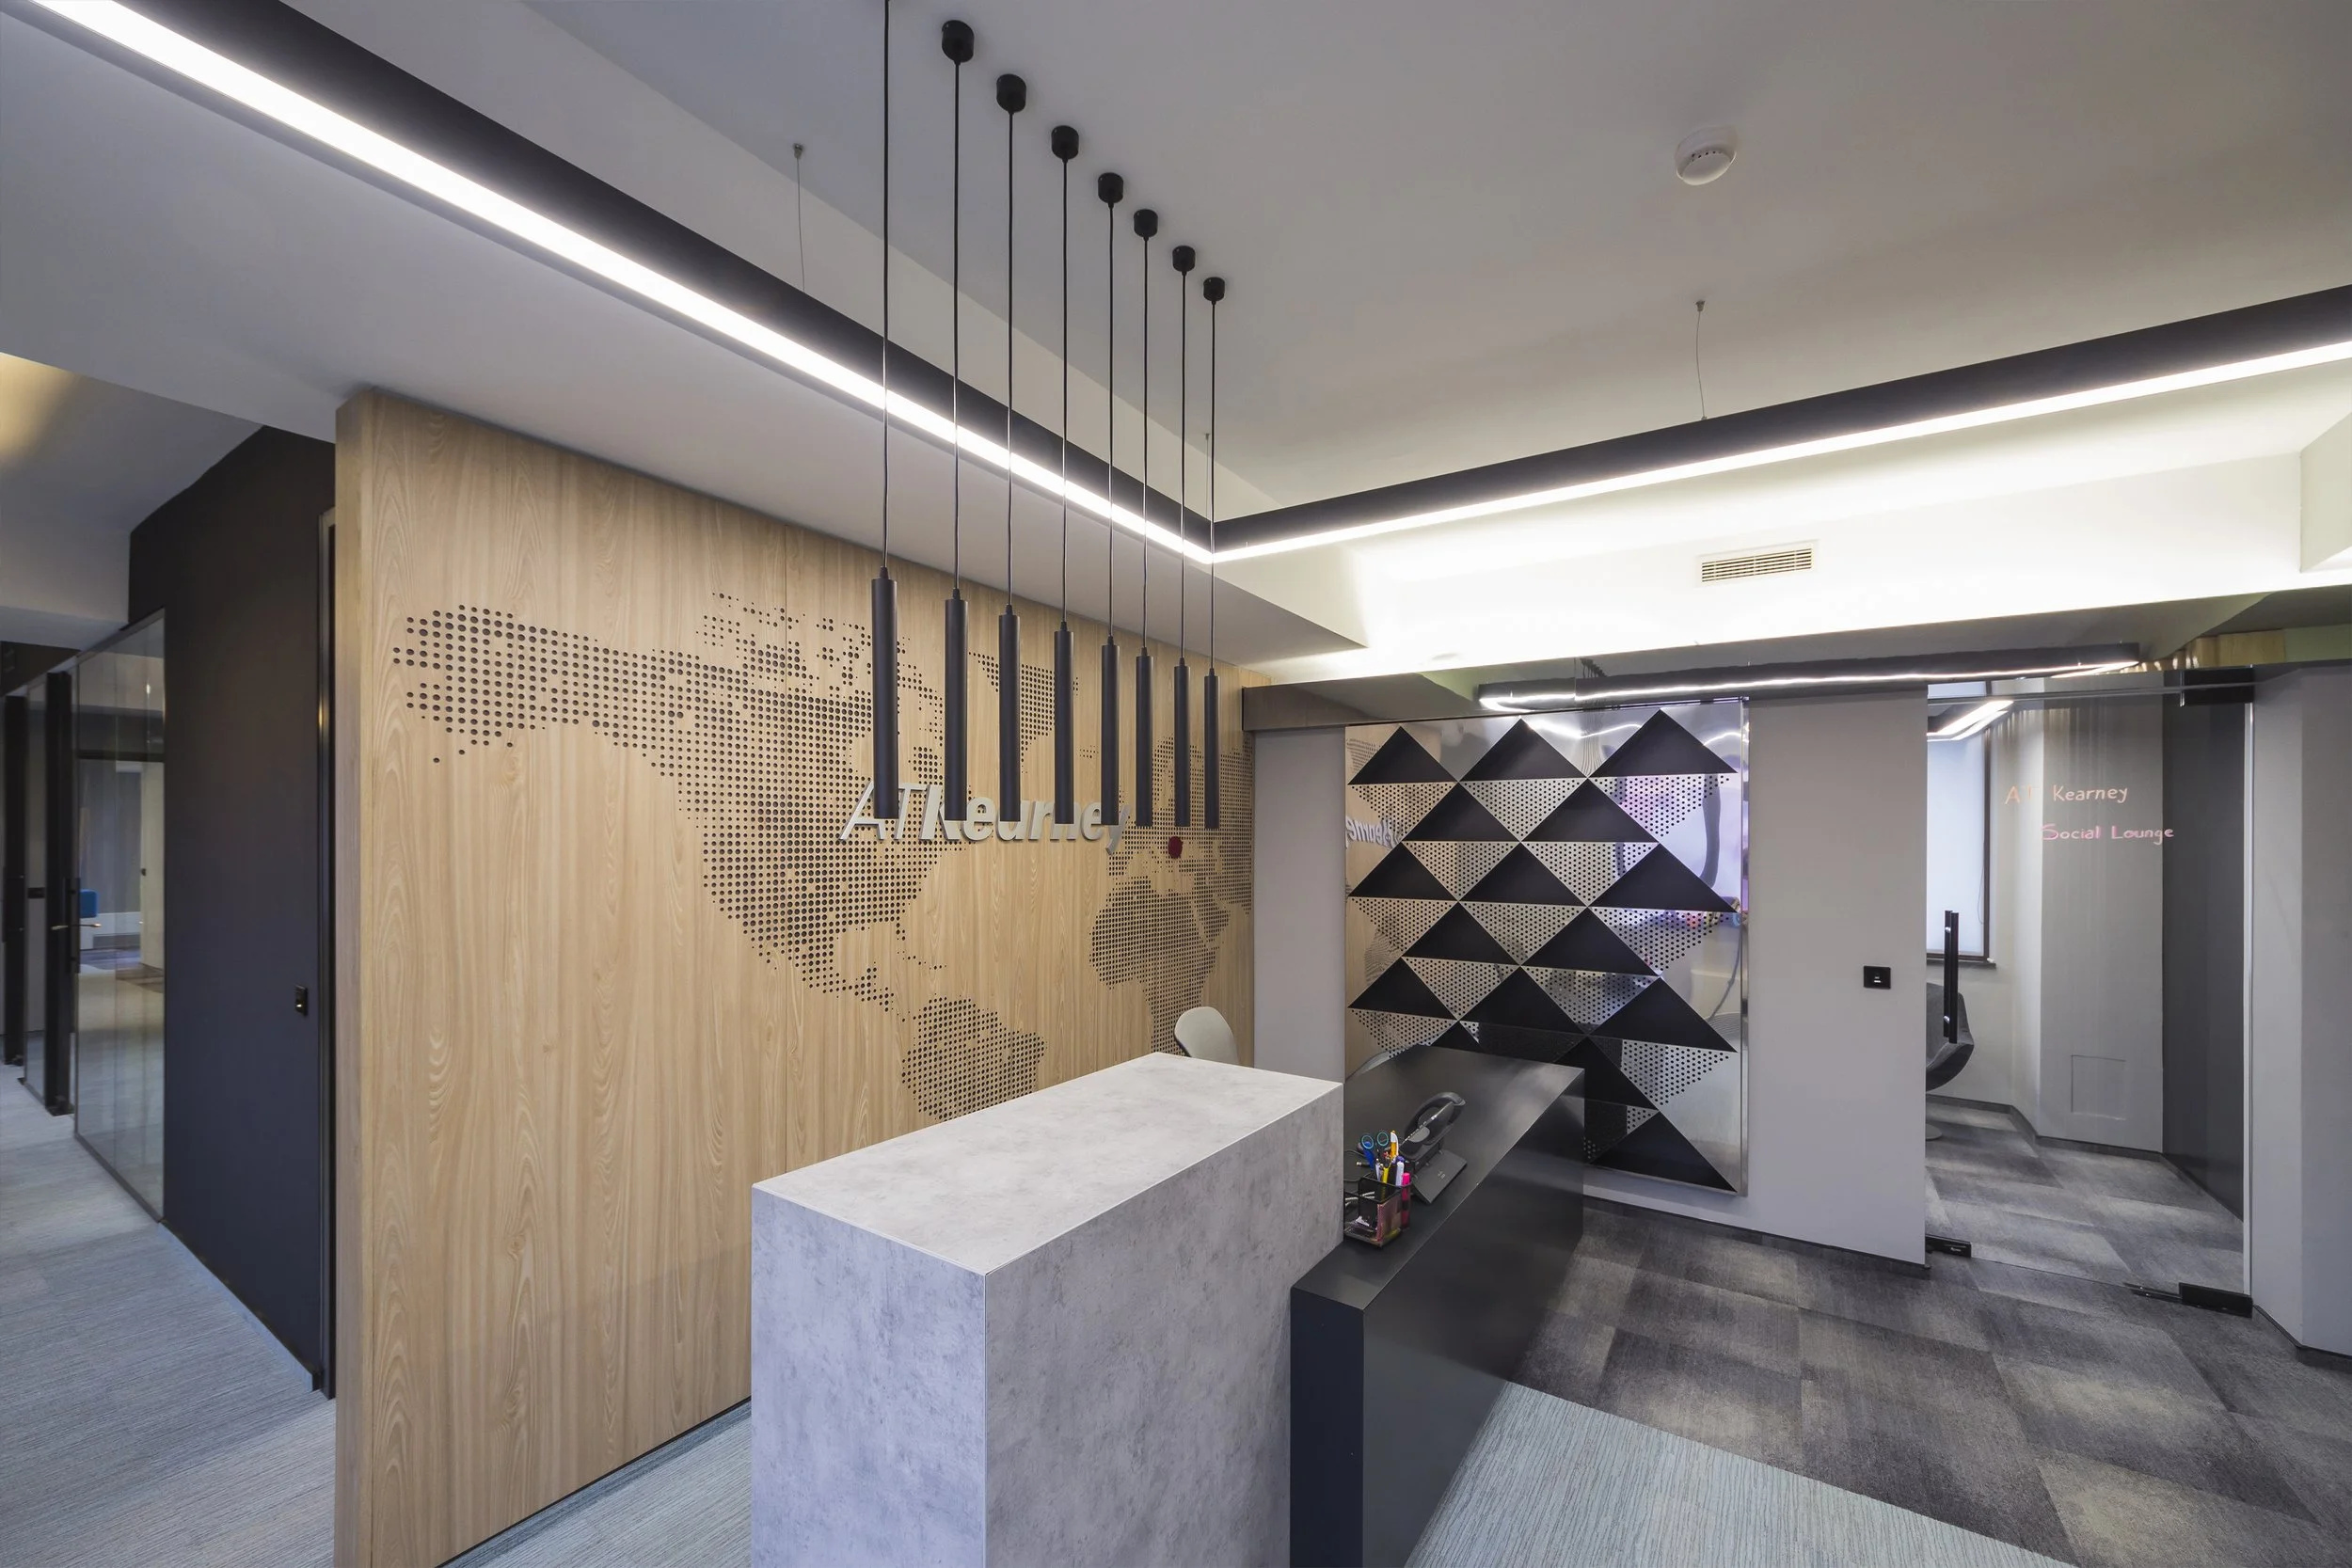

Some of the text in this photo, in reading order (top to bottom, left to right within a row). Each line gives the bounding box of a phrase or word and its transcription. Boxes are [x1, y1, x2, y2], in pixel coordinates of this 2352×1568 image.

[2052, 784, 2128, 803] Kearney
[2040, 823, 2174, 846] Social Lounge
